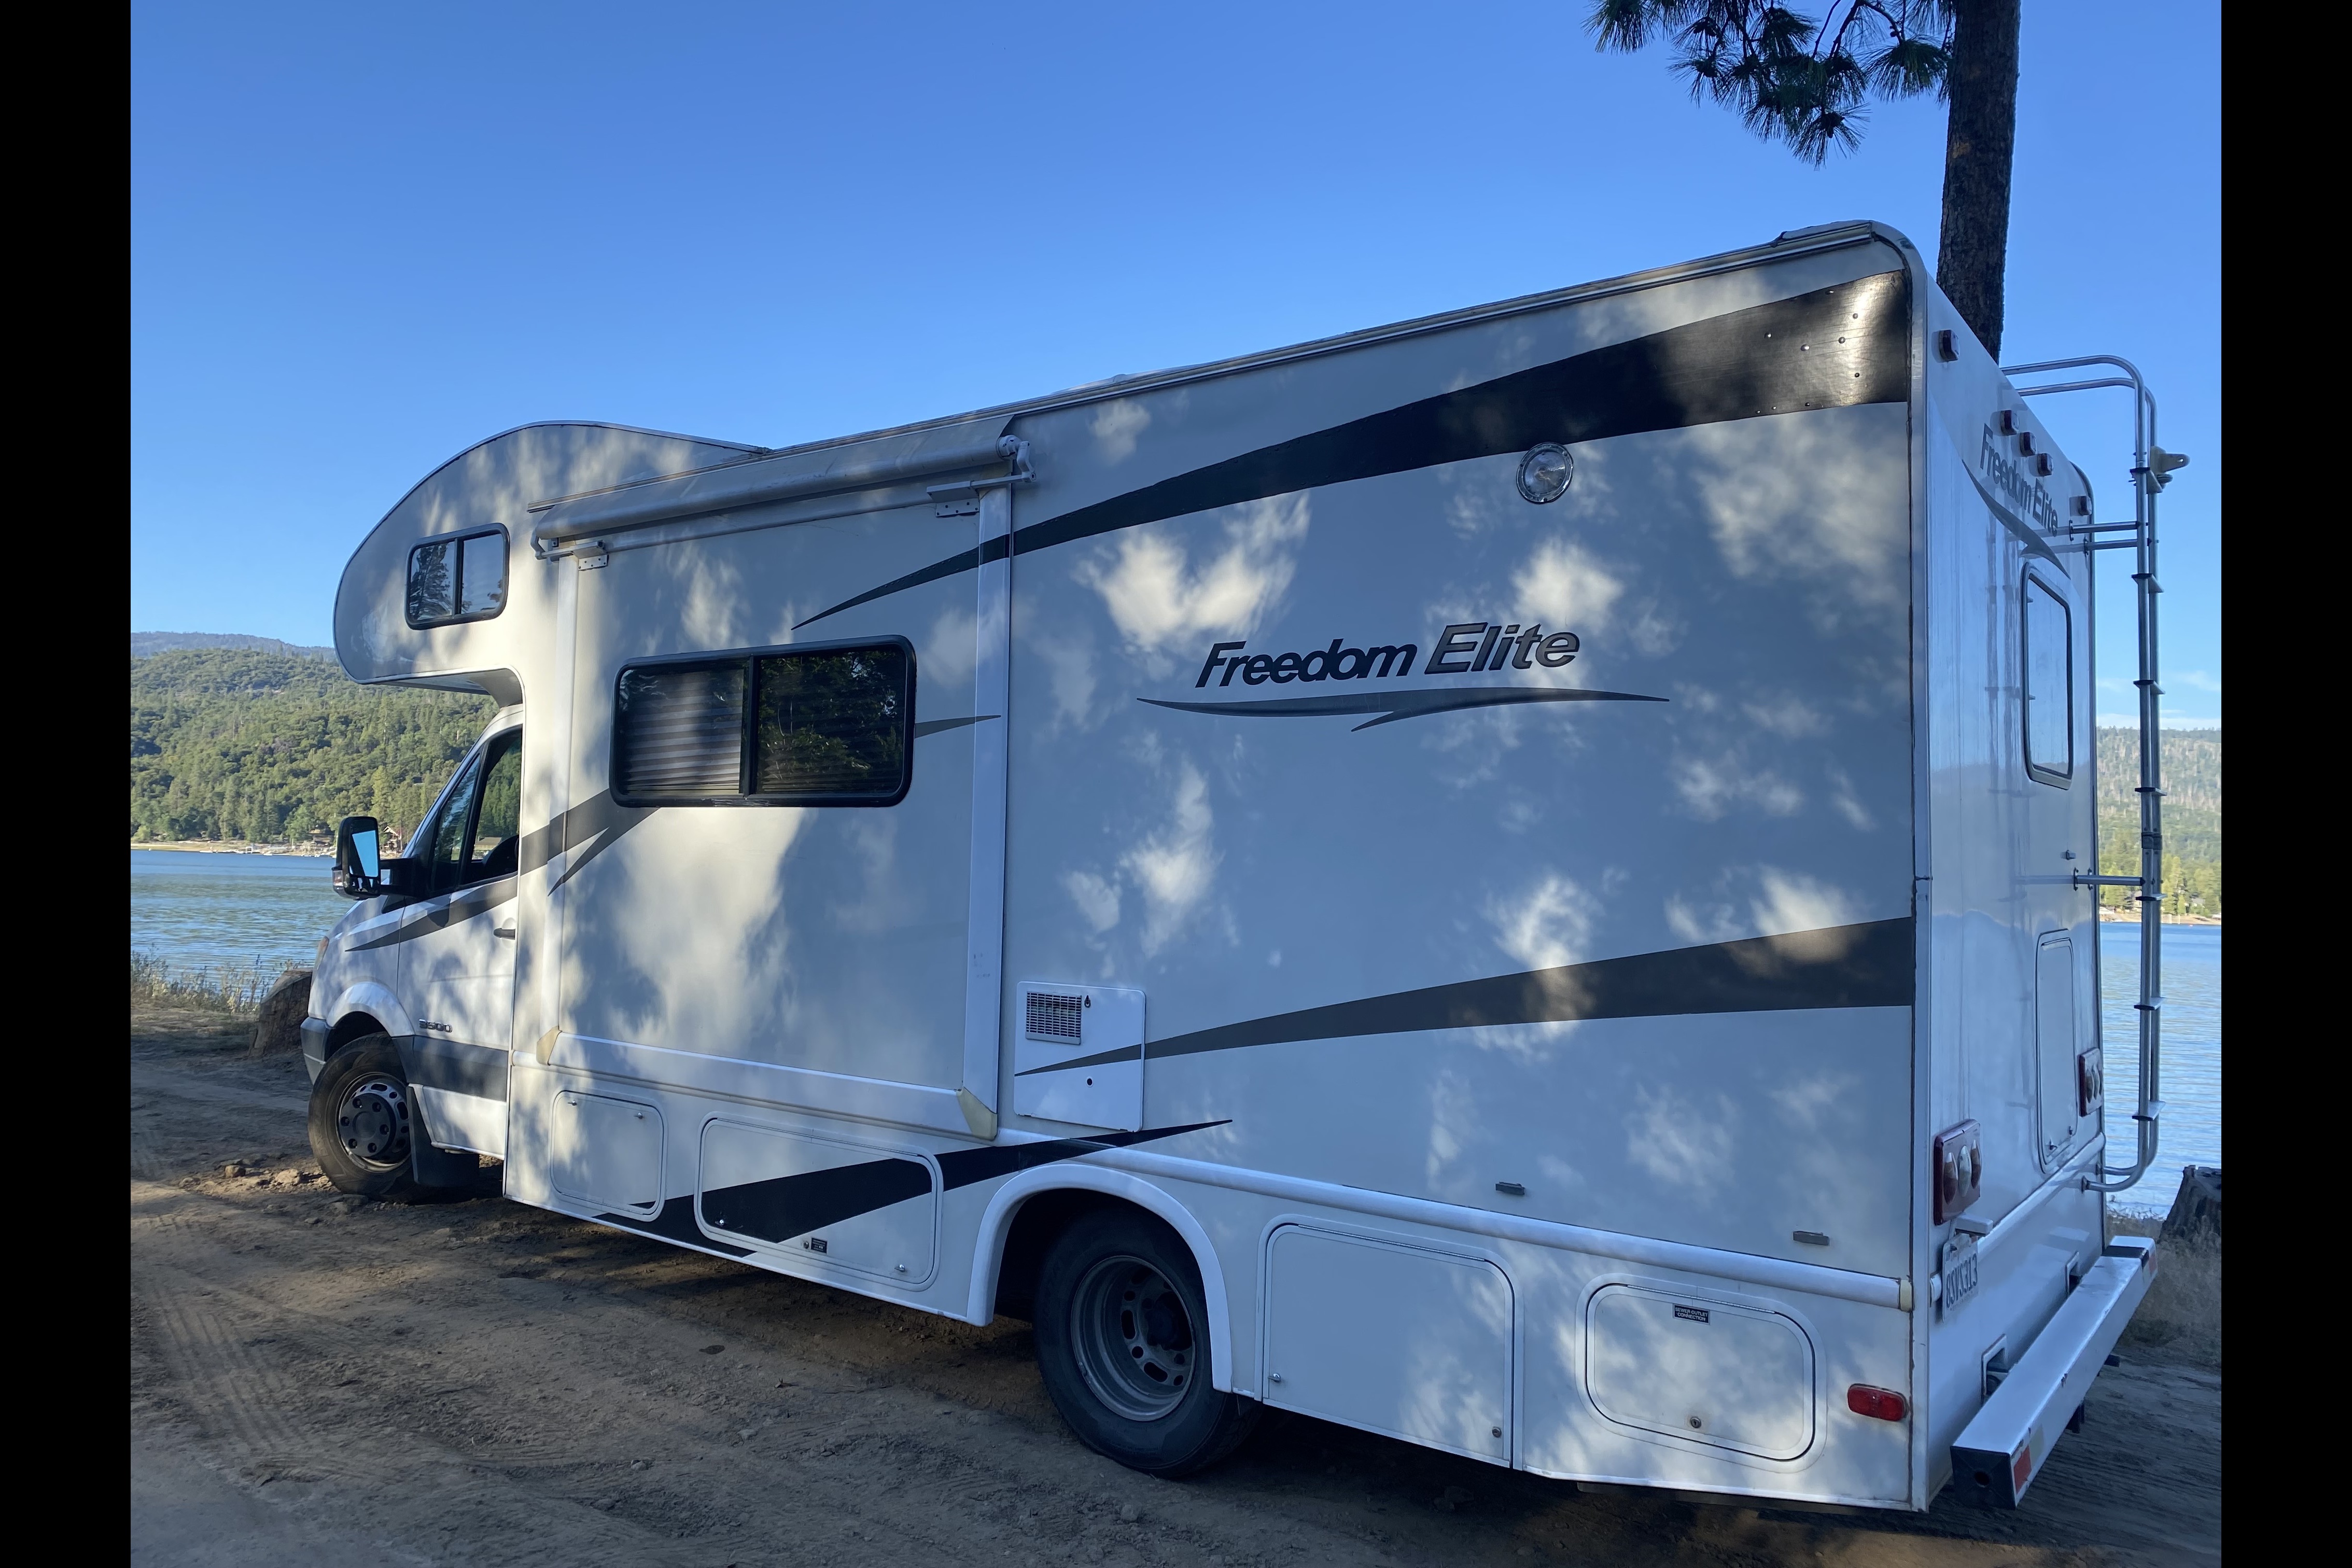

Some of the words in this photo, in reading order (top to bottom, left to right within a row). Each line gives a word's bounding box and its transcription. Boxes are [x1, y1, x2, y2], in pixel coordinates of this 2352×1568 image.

[1980, 423, 2032, 514] Freedom
[2033, 478, 2058, 537] Elite
[1195, 638, 1418, 688] Freedom
[1424, 622, 1580, 675] Elite
[419, 1019, 453, 1033] 3500
[1677, 1312, 1706, 1322] CONNECTION
